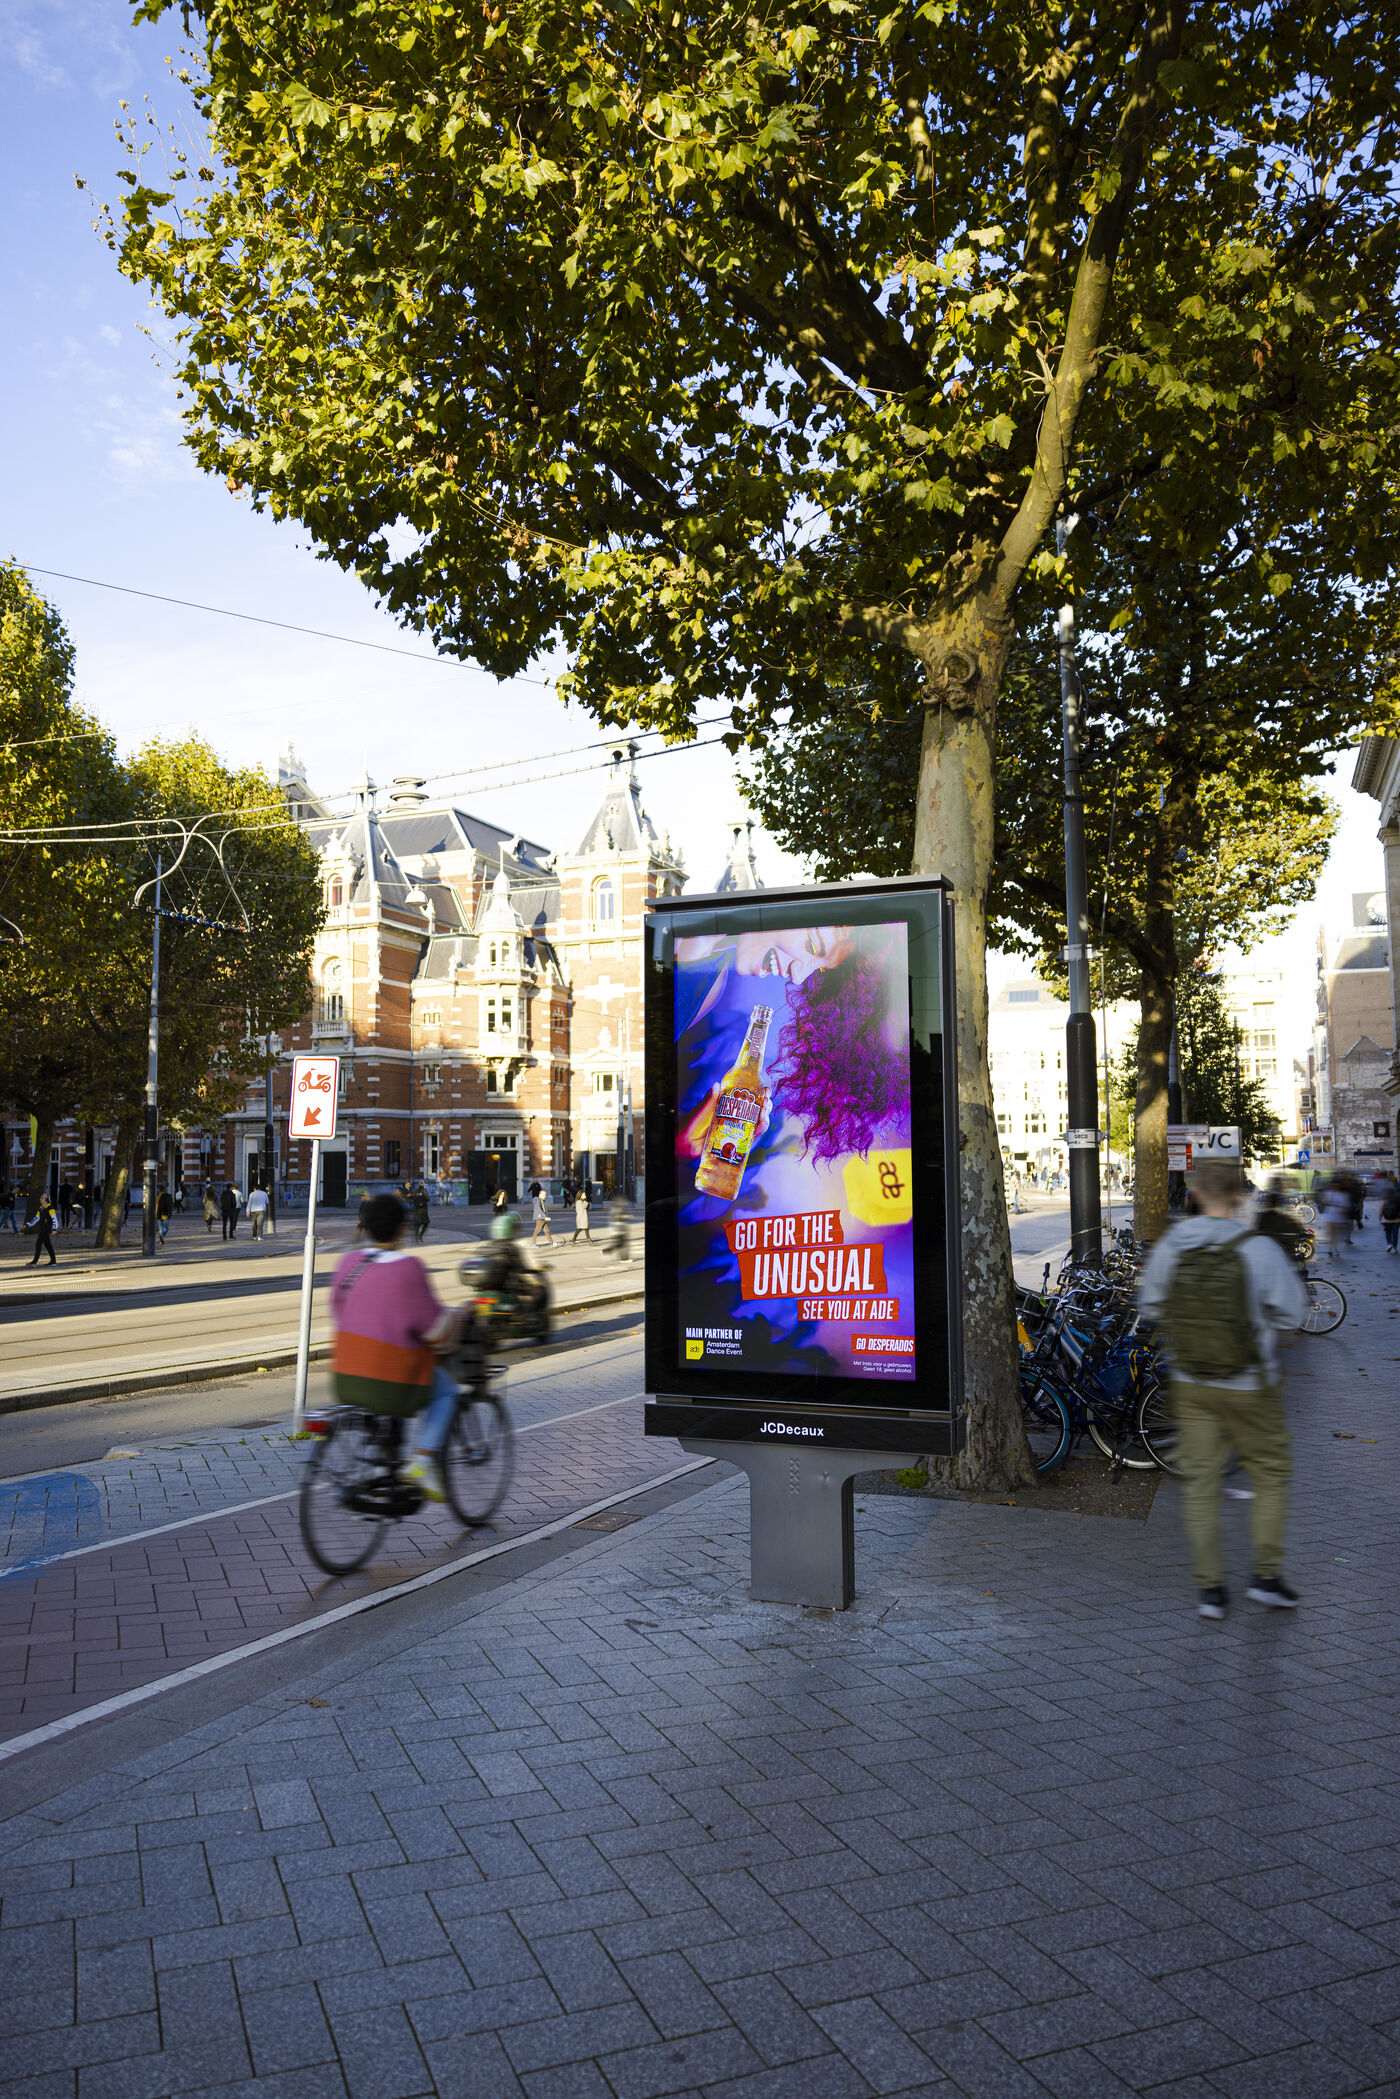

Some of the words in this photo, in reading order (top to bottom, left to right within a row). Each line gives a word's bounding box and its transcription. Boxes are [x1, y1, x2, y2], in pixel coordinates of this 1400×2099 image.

[735, 1221, 757, 1250] GO
[763, 1217, 796, 1248] FOR
[801, 1213, 834, 1244] THE
[753, 1248, 875, 1296] UNUSUAL
[803, 1301, 824, 1320] SEE
[828, 1301, 850, 1320] YOU
[852, 1301, 868, 1320] AT
[869, 1301, 894, 1320] ADE
[686, 1327, 703, 1338] MAIN
[704, 1328, 733, 1340] PARTNER
[734, 1329, 743, 1340] OF
[706, 1347, 725, 1355] Dance
[726, 1348, 743, 1356] Event
[856, 1337, 866, 1350] GO
[867, 1338, 914, 1352] DESPERADOS
[760, 1422, 825, 1437] JCDecaux
